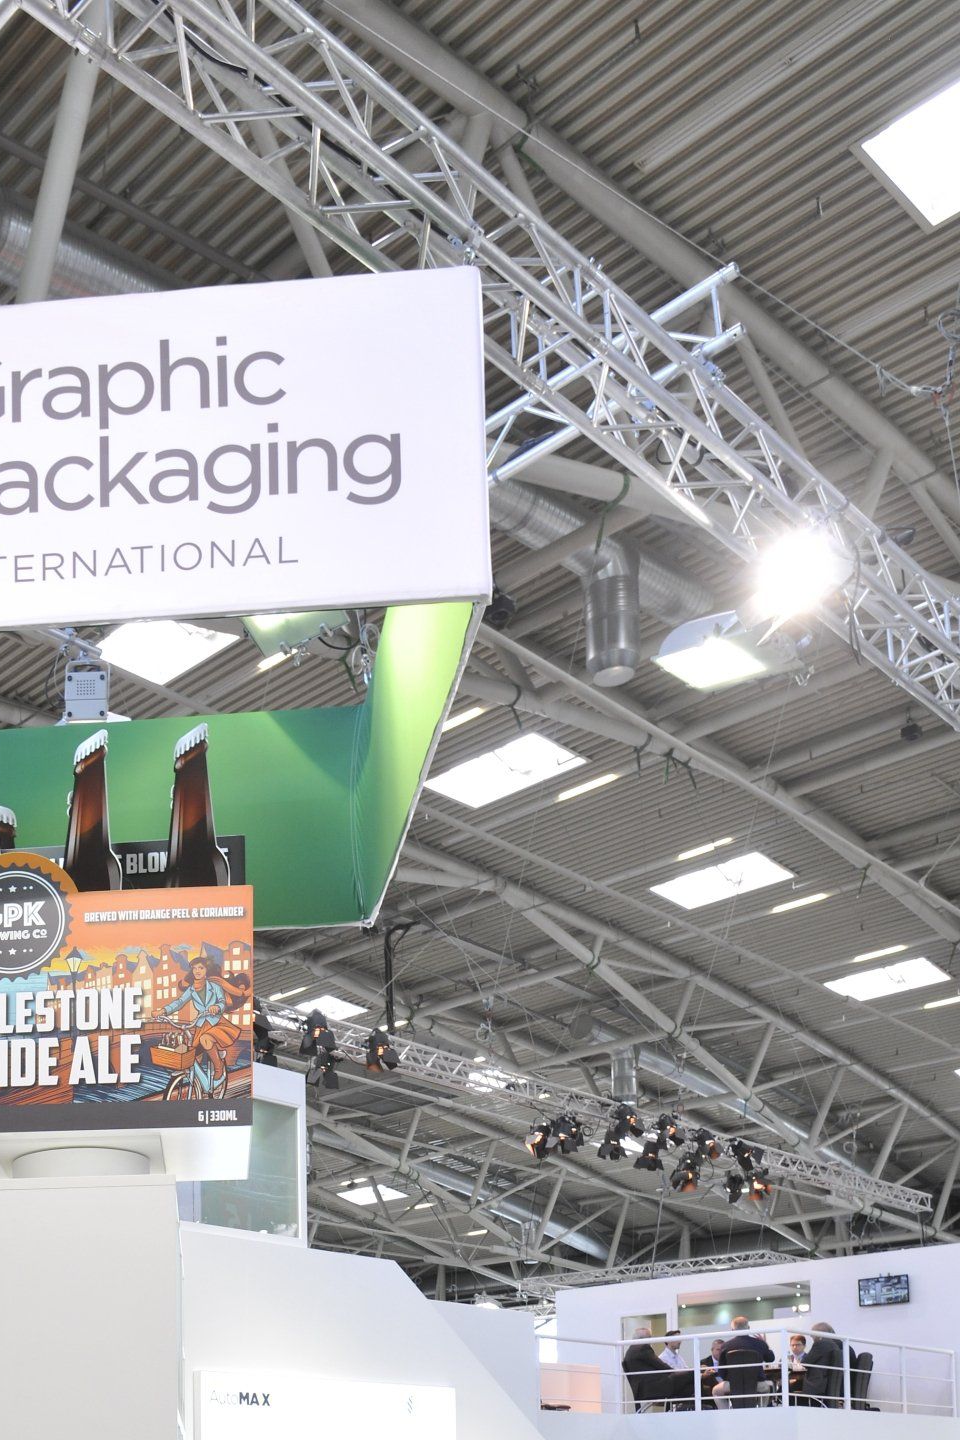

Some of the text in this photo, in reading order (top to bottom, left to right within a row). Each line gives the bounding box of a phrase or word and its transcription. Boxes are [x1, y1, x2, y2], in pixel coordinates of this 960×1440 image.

[126, 852, 169, 875] BLON
[84, 906, 244, 923] BREWED WITH ORANGE PEEL & CORIANDER
[69, 1033, 142, 1086] ALE
